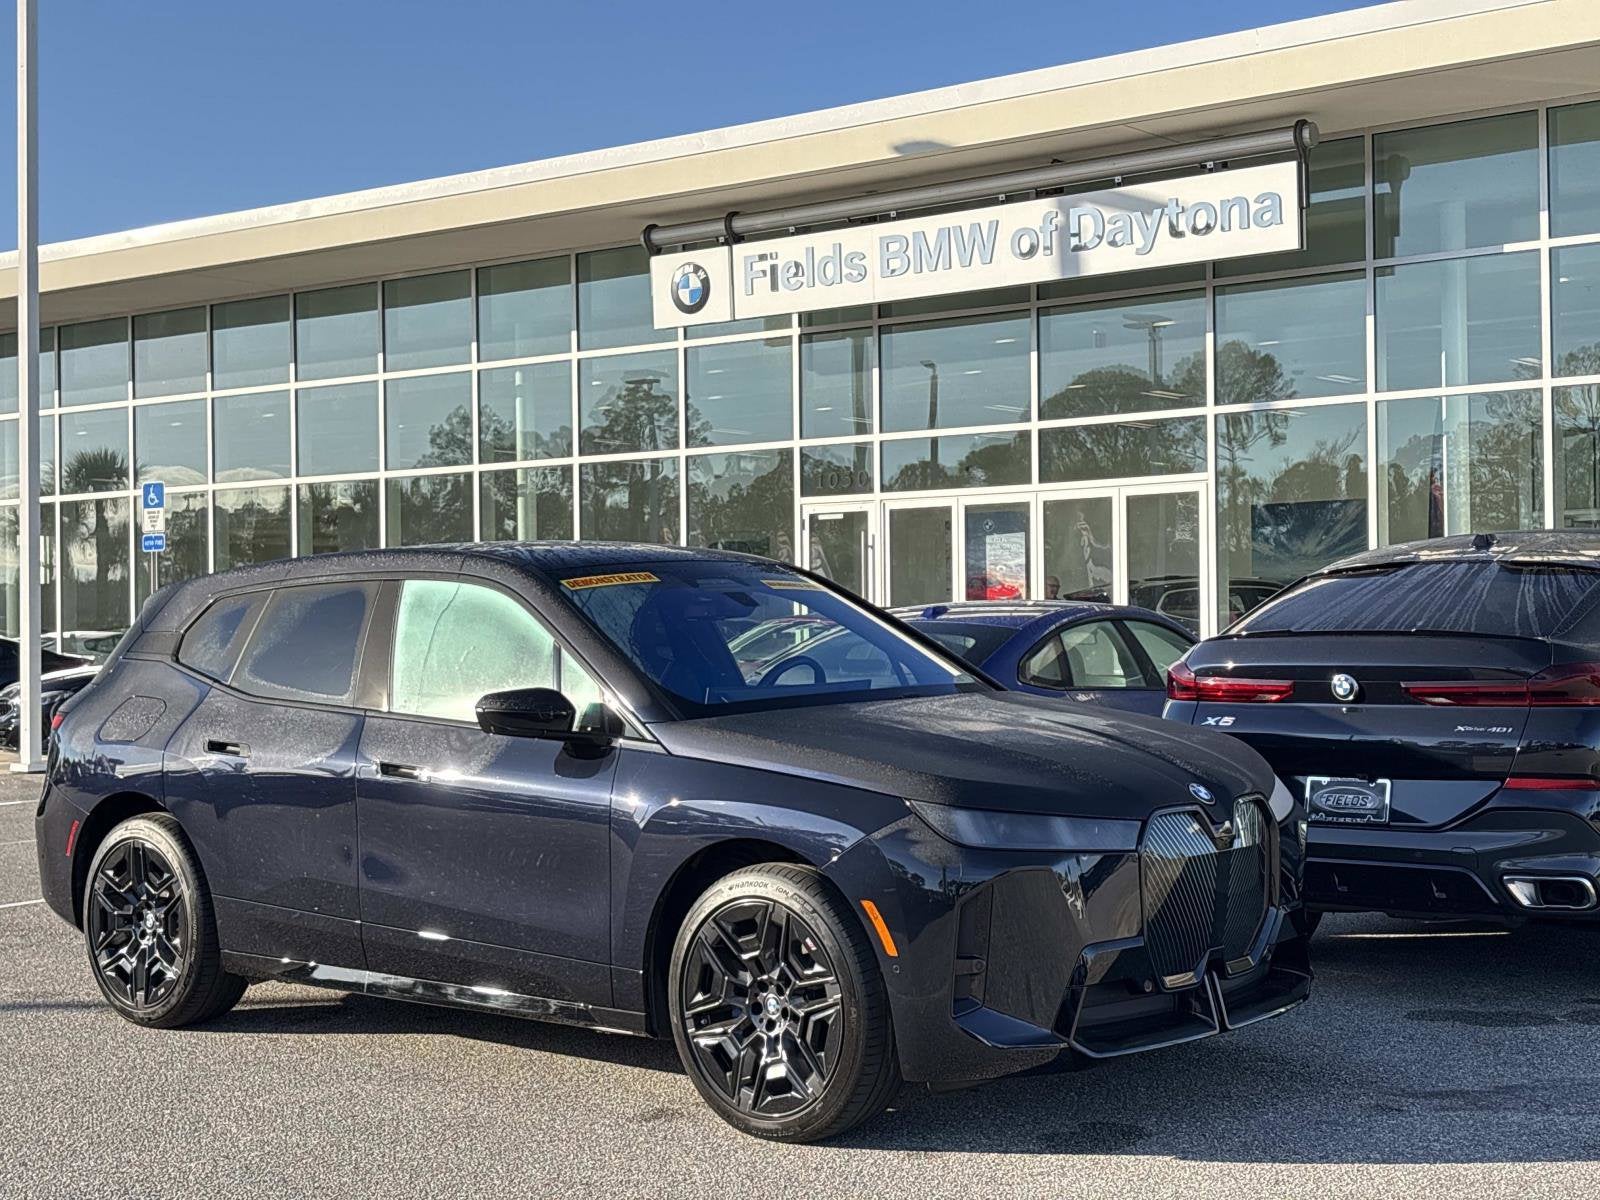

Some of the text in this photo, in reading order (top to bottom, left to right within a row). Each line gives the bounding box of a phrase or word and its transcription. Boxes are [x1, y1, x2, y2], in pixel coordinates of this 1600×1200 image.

[743, 190, 1284, 296] Fields BMW of Daytona
[565, 573, 655, 588] DEMONSTRATOR
[1200, 716, 1236, 726] X6
